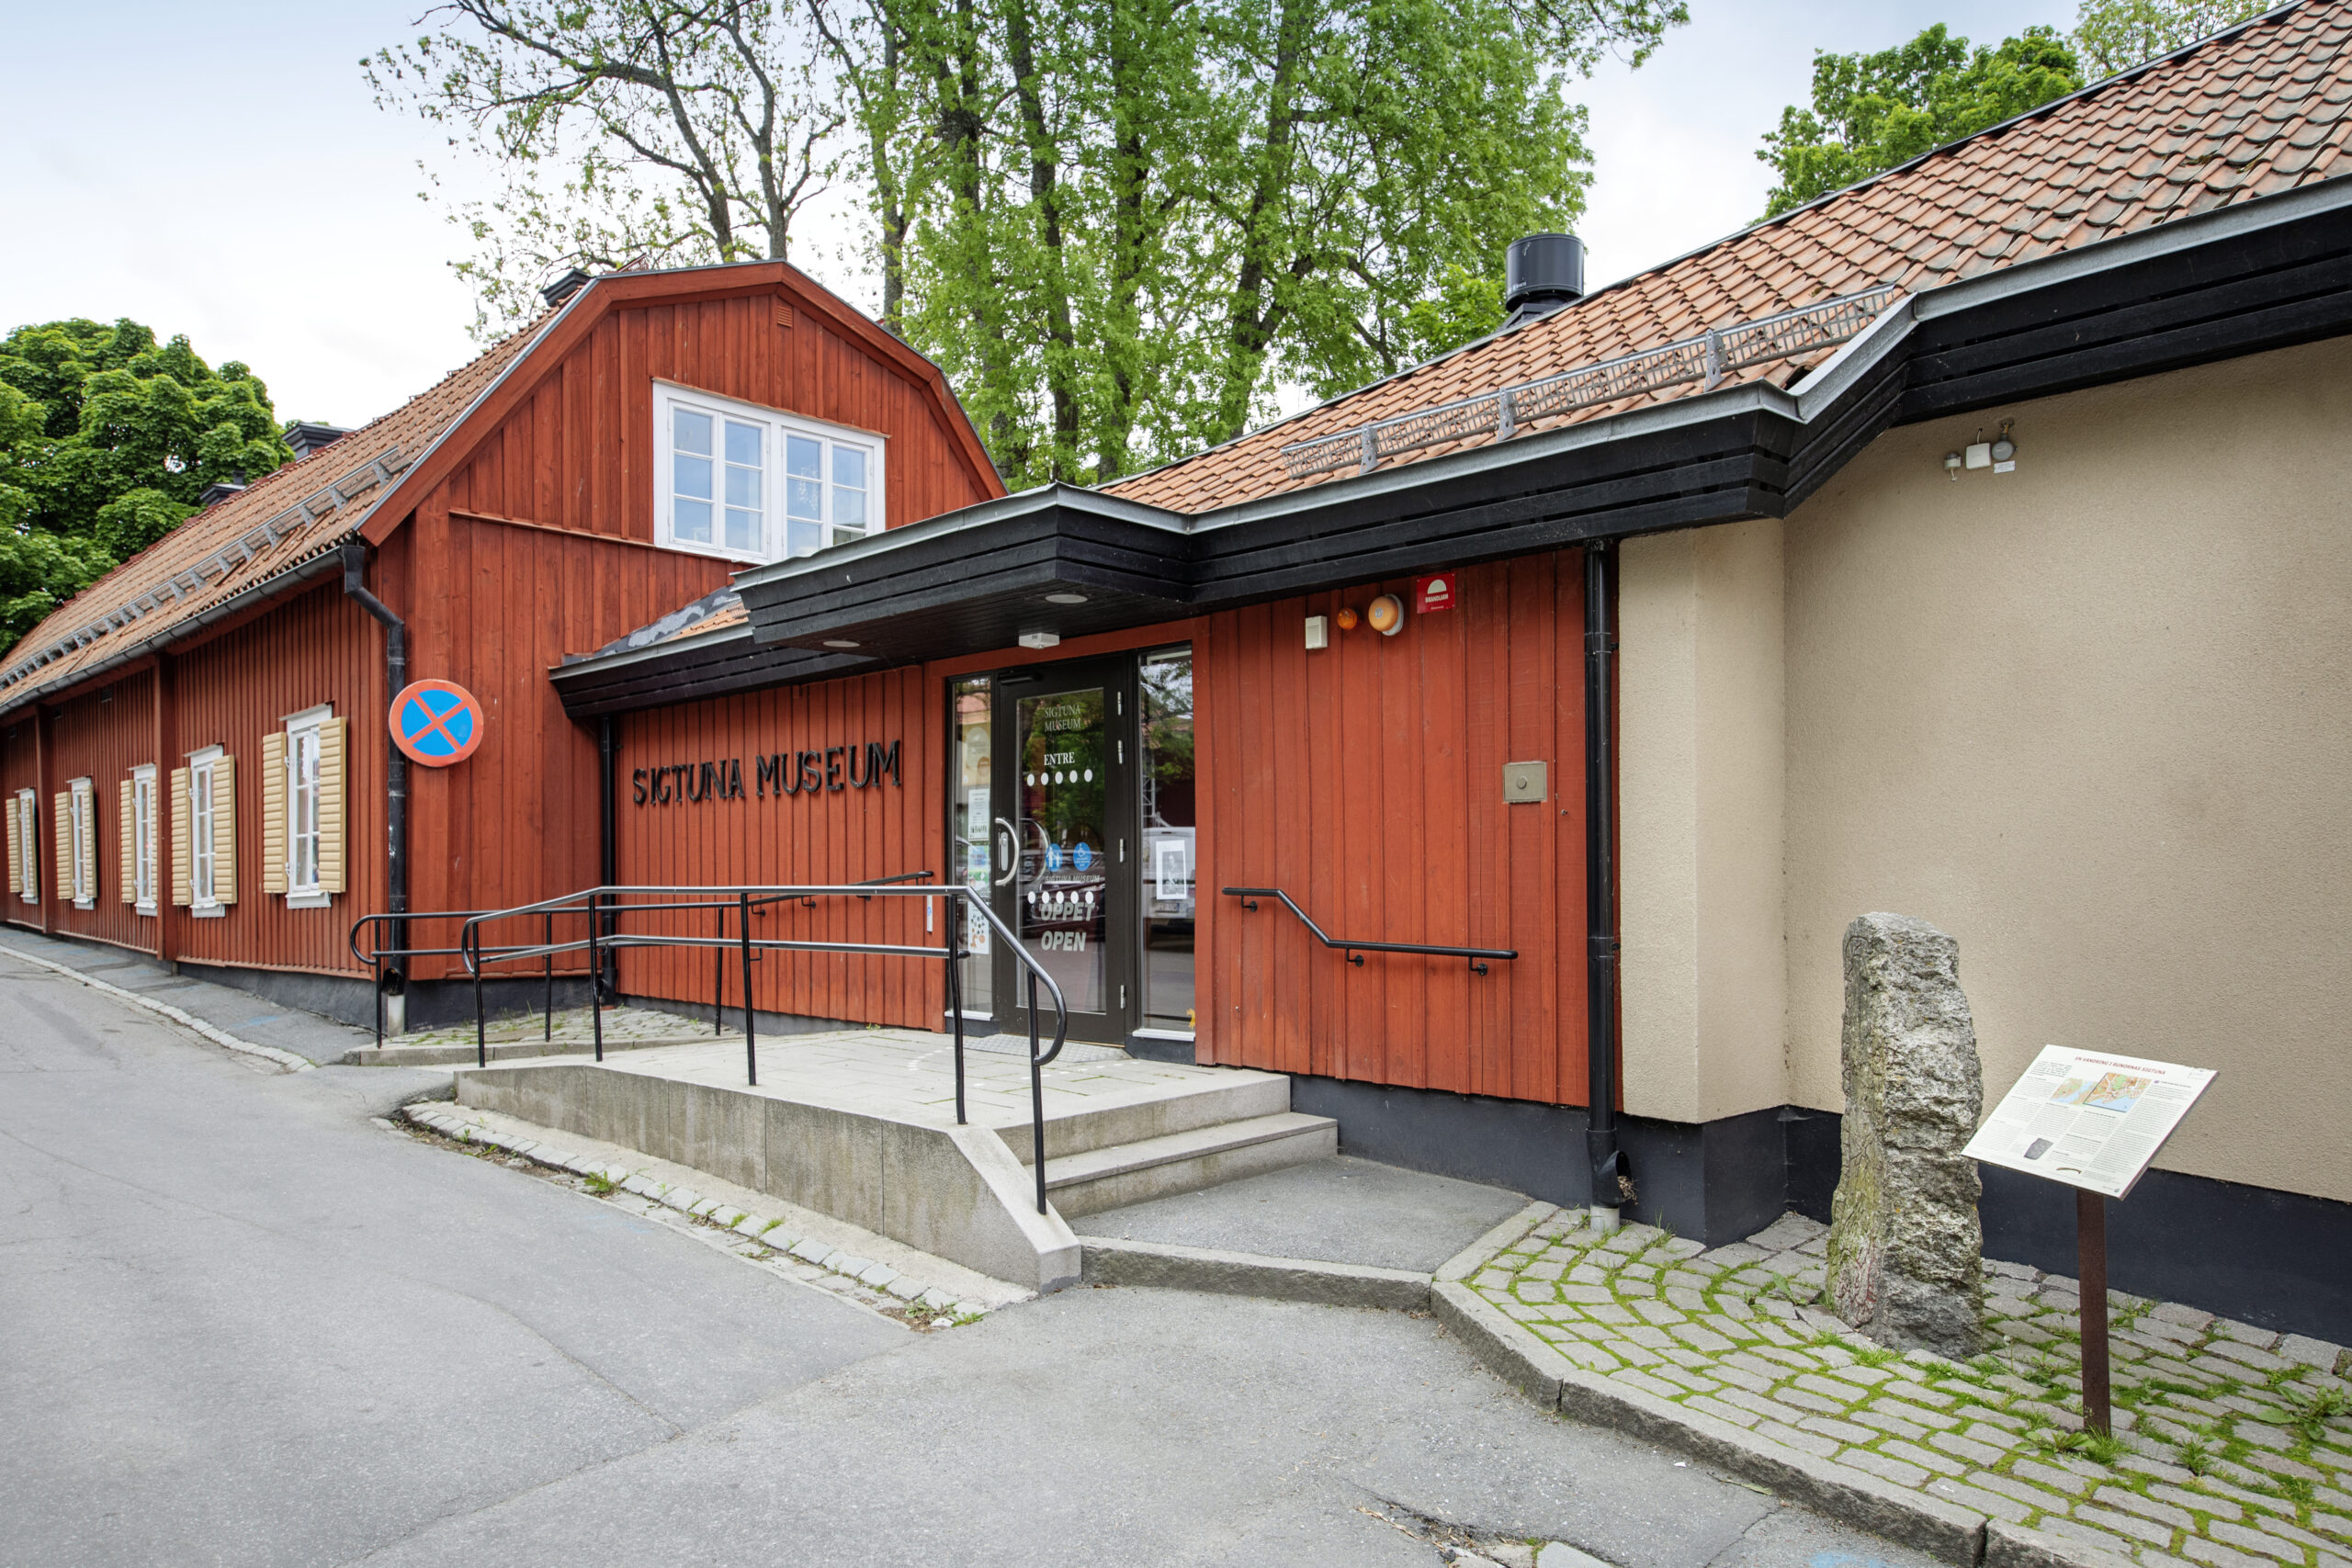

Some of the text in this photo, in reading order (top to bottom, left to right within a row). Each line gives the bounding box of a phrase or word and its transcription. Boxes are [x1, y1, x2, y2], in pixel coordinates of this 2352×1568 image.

[1425, 593, 1449, 603] BRANDLARM
[1045, 705, 1081, 718] SIGTUNA
[1045, 717, 1081, 732] MUSEUM
[1044, 751, 1076, 765] ENTRE
[633, 739, 901, 805] SIGTUNA MUSEUM
[1072, 874, 1100, 883] MUSEUM
[1041, 931, 1086, 952] OPEN
[2142, 1066, 2166, 1075] SIGTUNA
